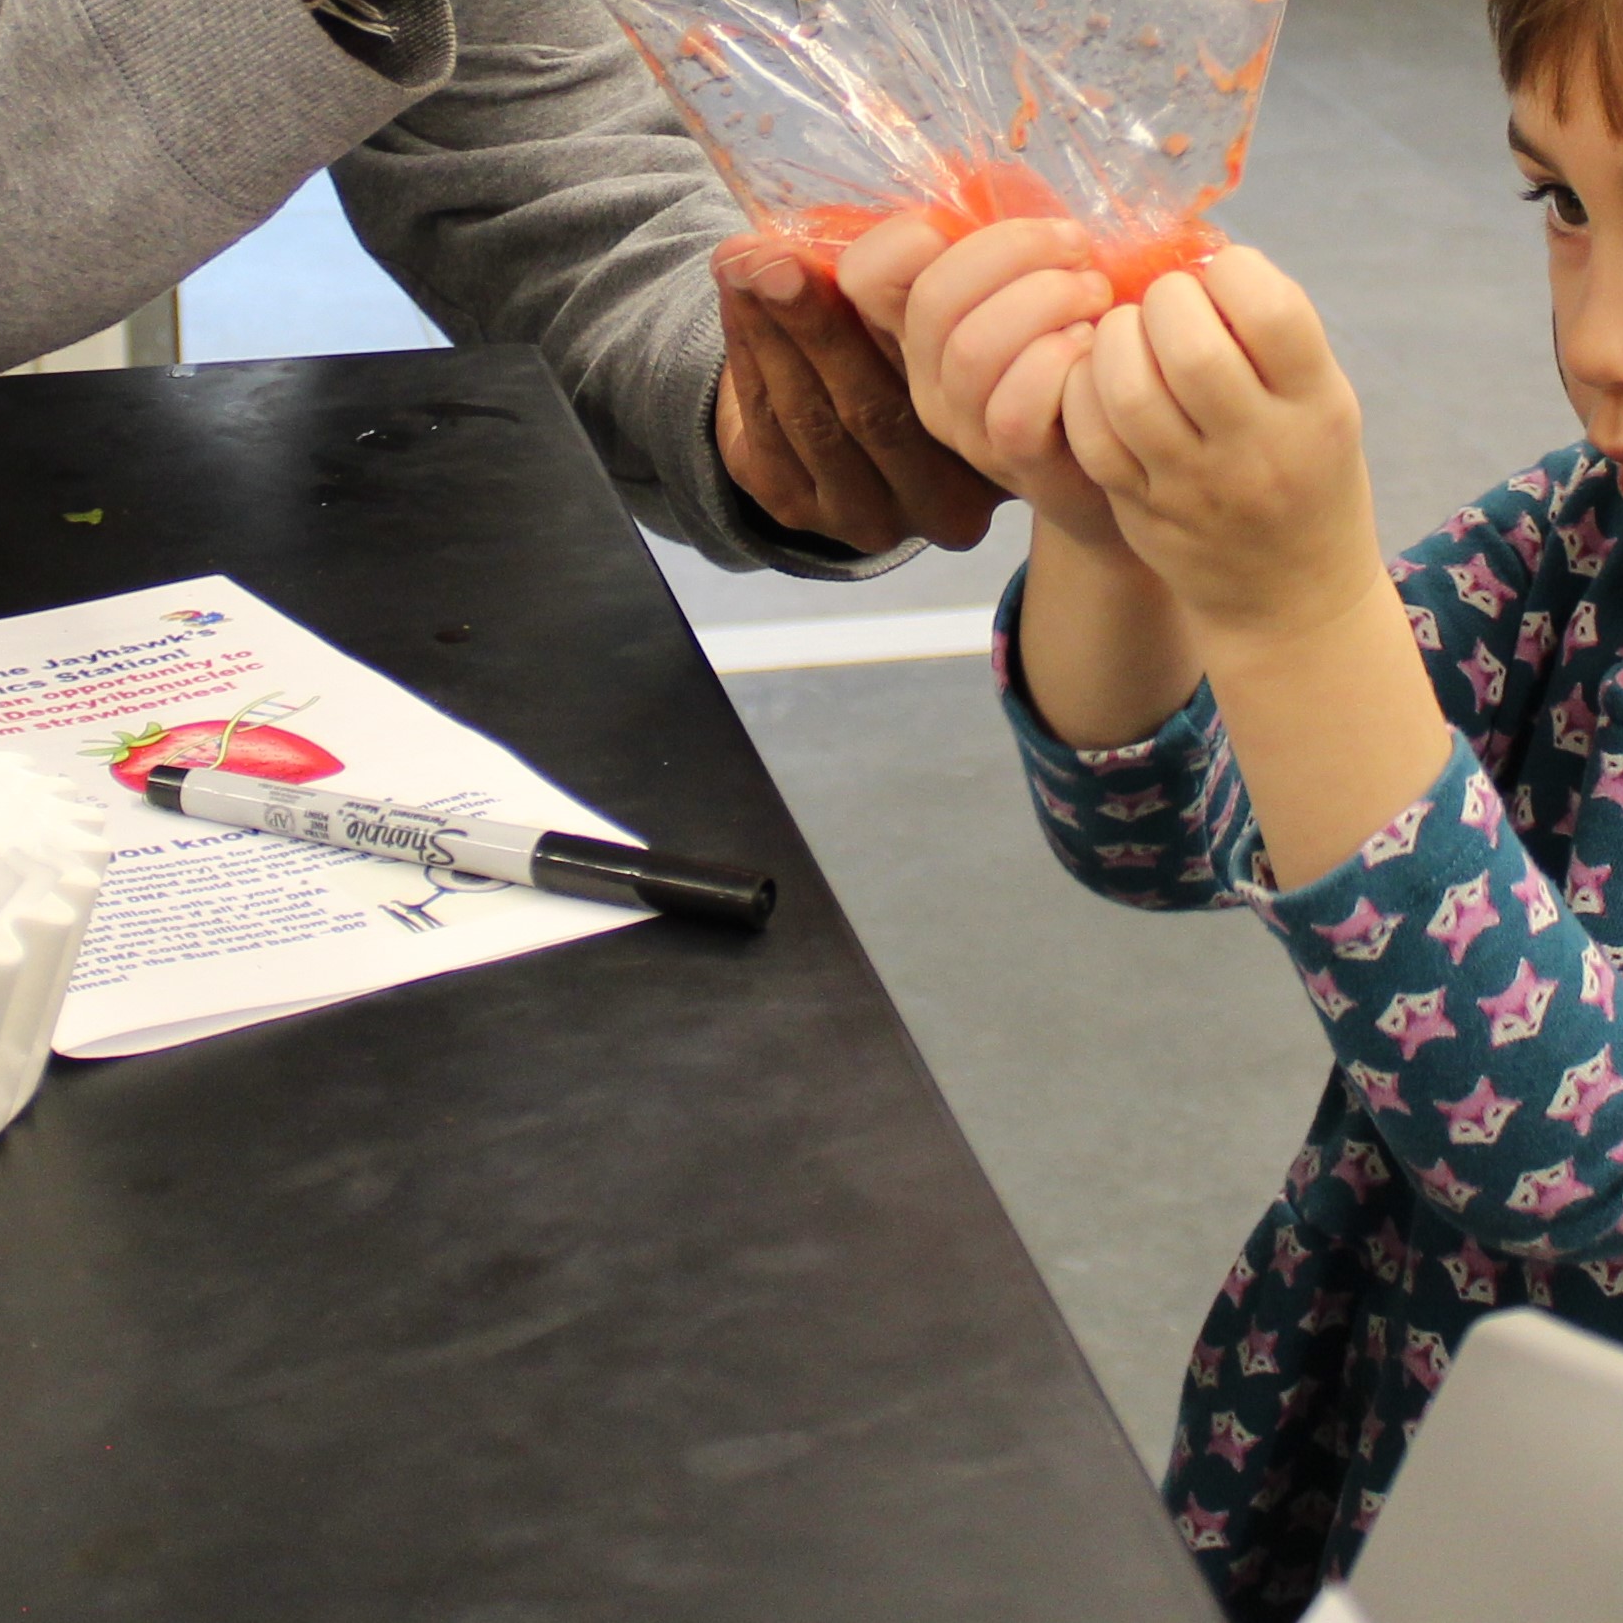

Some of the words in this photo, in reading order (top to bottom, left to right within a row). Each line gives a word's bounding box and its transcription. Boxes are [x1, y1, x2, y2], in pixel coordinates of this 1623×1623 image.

[41, 628, 217, 671] Jayhawk's
[53, 648, 191, 683] Station!
[40, 658, 215, 701] opportunity
[220, 650, 254, 662] to
[32, 681, 239, 731] strawberries!
[343, 814, 470, 866] Sharpie
[389, 808, 449, 828] Permanent
[106, 854, 224, 876] instructions
[227, 848, 255, 857] for
[260, 842, 284, 851] an
[108, 880, 180, 896] unwind
[185, 873, 221, 885] and
[223, 867, 261, 878] link
[264, 860, 297, 870] the
[94, 899, 122, 909] he
[127, 890, 171, 904] DNA
[175, 881, 234, 896] would
[236, 876, 262, 886] be
[282, 863, 323, 877] feet
[96, 908, 163, 923] trillion
[168, 899, 216, 913] cells
[218, 895, 239, 903] in
[242, 885, 285, 900] your
[119, 914, 185, 929] means
[210, 904, 235, 915] all
[239, 896, 280, 911] your
[284, 887, 330, 901] DNA
[81, 933, 115, 947] put
[233, 912, 250, 921] it
[255, 900, 313, 917] would
[81, 946, 108, 957] ch
[114, 938, 156, 950] over
[162, 930, 199, 942] 110
[201, 921, 264, 937] billion
[268, 908, 328, 925] miles!
[94, 950, 143, 965] DNA
[146, 940, 203, 956] could
[206, 929, 279, 946] stretch
[281, 919, 330, 933] from
[331, 911, 366, 922] the
[69, 967, 112, 981] arth
[115, 963, 139, 972] to
[141, 956, 177, 967] the
[180, 949, 222, 961] Sun
[225, 941, 264, 954] and
[264, 932, 317, 947] back
